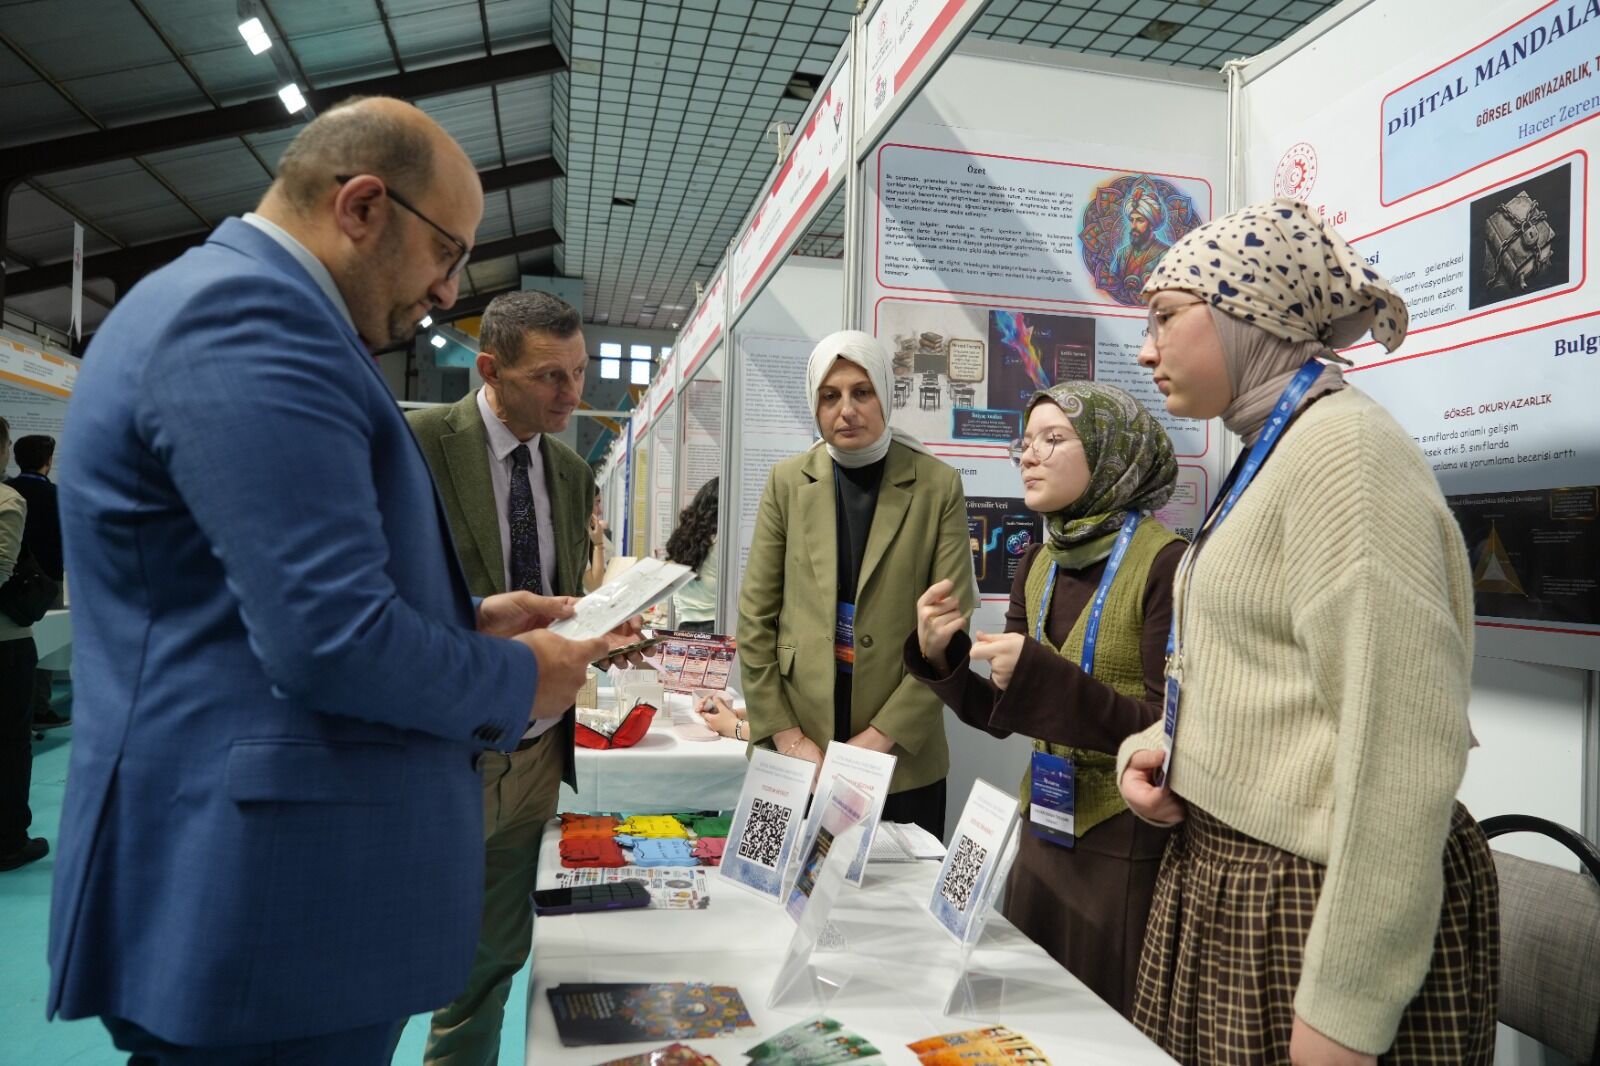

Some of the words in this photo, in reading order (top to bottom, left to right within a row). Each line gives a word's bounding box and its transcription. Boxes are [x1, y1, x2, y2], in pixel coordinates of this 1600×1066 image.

[1387, 75, 1468, 136] DİJİTAL
[1474, 0, 1600, 87] MANDALA
[1476, 101, 1513, 127] GÖRSEL
[1515, 61, 1592, 111] OKURYAZARLIK,
[1518, 115, 1556, 140] Hacer
[1559, 95, 1600, 123] Zeren
[967, 164, 986, 176] Özet
[1425, 252, 1464, 276] geleneksel
[1404, 271, 1464, 294] motivasyonlarını
[1437, 285, 1464, 300] ezbere
[1554, 333, 1600, 357] Bulg
[1443, 406, 1475, 420] GÖRSEL
[1478, 393, 1552, 414] OKURYAZARLIK
[1422, 429, 1458, 443] sınıflarda
[1460, 426, 1486, 438] anlamlı
[1488, 423, 1519, 437] gelişim
[1469, 439, 1510, 452] sınıflarda
[1433, 460, 1458, 472] anlama
[1459, 461, 1469, 470] ve
[1469, 456, 1515, 471] yorumlama
[1517, 450, 1552, 464] becerisi
[1553, 448, 1577, 460] arttı
[965, 499, 994, 510] Güvenilir
[995, 500, 1008, 510] Veri
